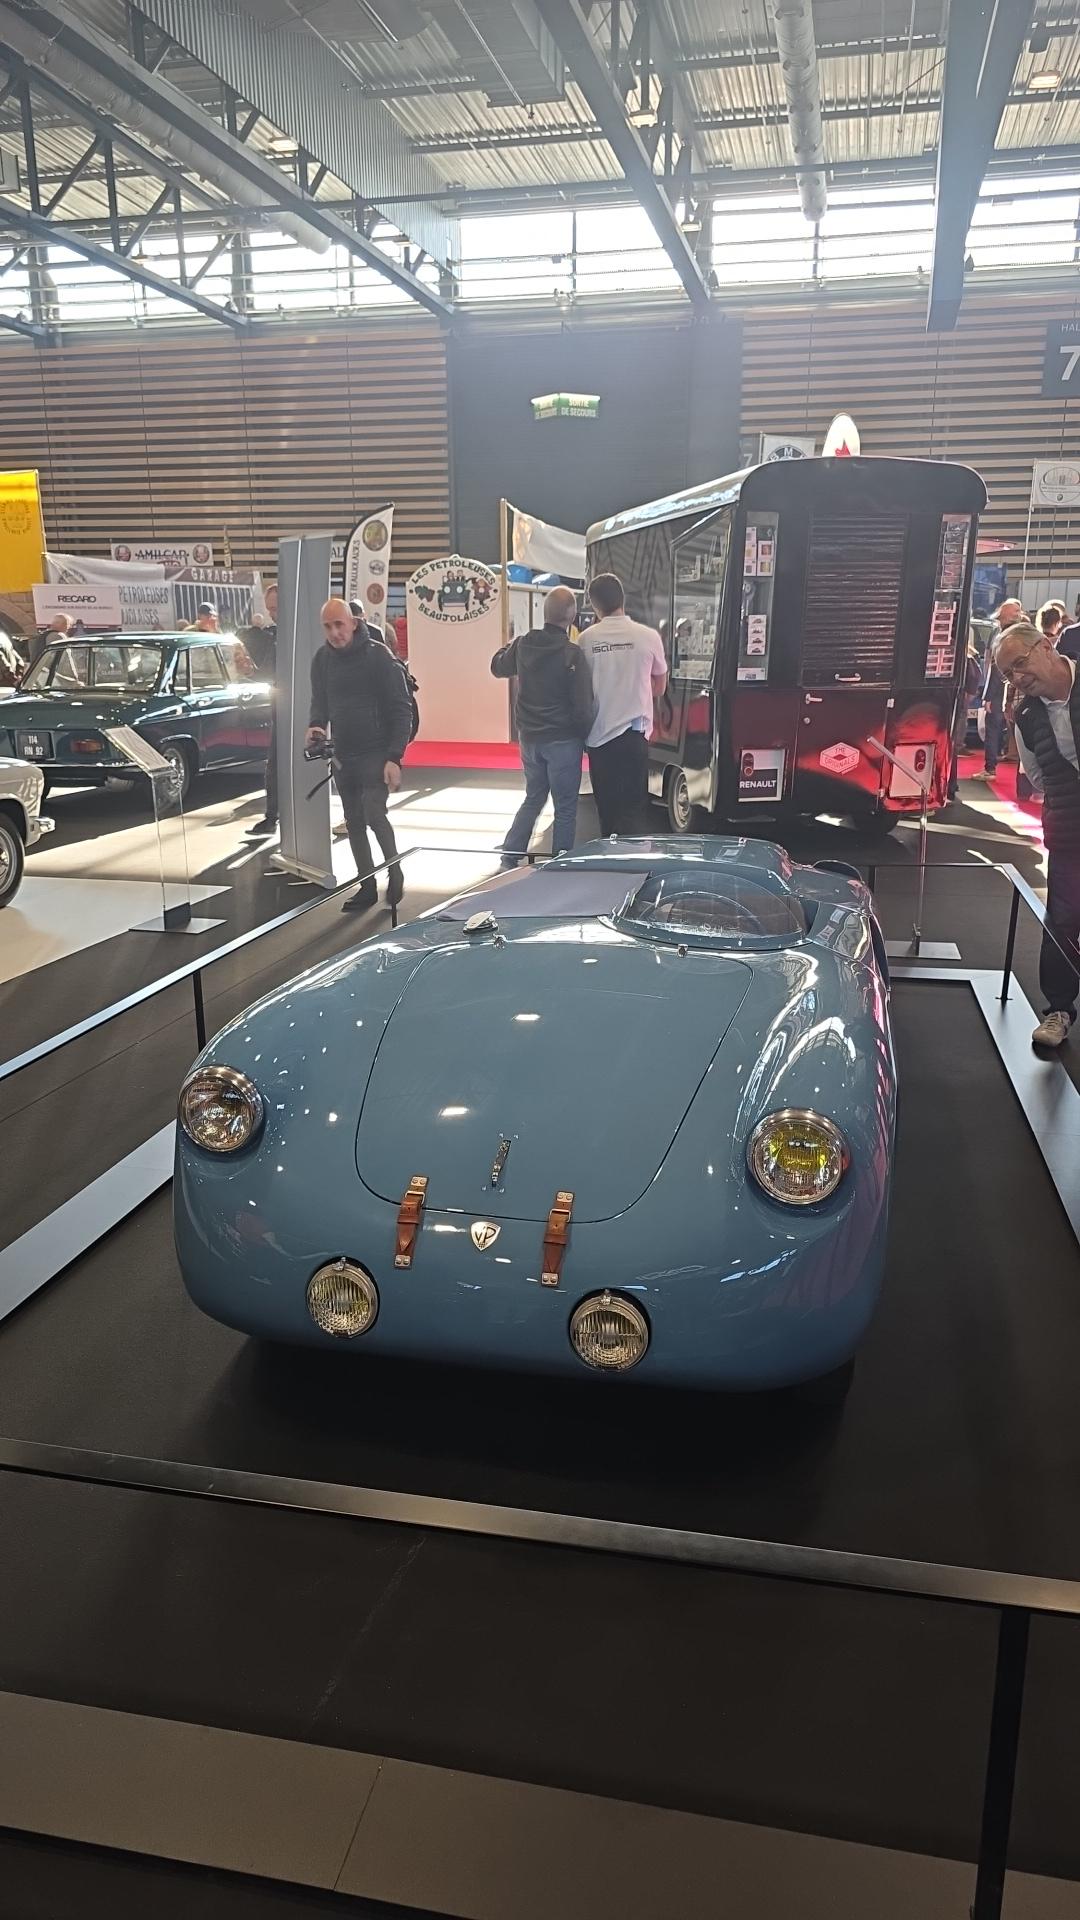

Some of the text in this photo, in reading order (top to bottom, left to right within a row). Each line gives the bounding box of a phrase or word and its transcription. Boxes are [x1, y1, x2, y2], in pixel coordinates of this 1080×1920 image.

[1060, 345, 1080, 381] 7
[136, 549, 189, 566] AMILCAR
[191, 567, 235, 583] GARAGE
[411, 560, 496, 586] LES PETROLEUSES
[57, 595, 97, 603] RECARO
[118, 586, 169, 604] PETROLEUSES
[121, 608, 160, 625] JOLAISES
[418, 603, 490, 622] BEAUJOLAISES
[739, 780, 777, 788] RENAULT
[475, 1226, 496, 1243] VP
